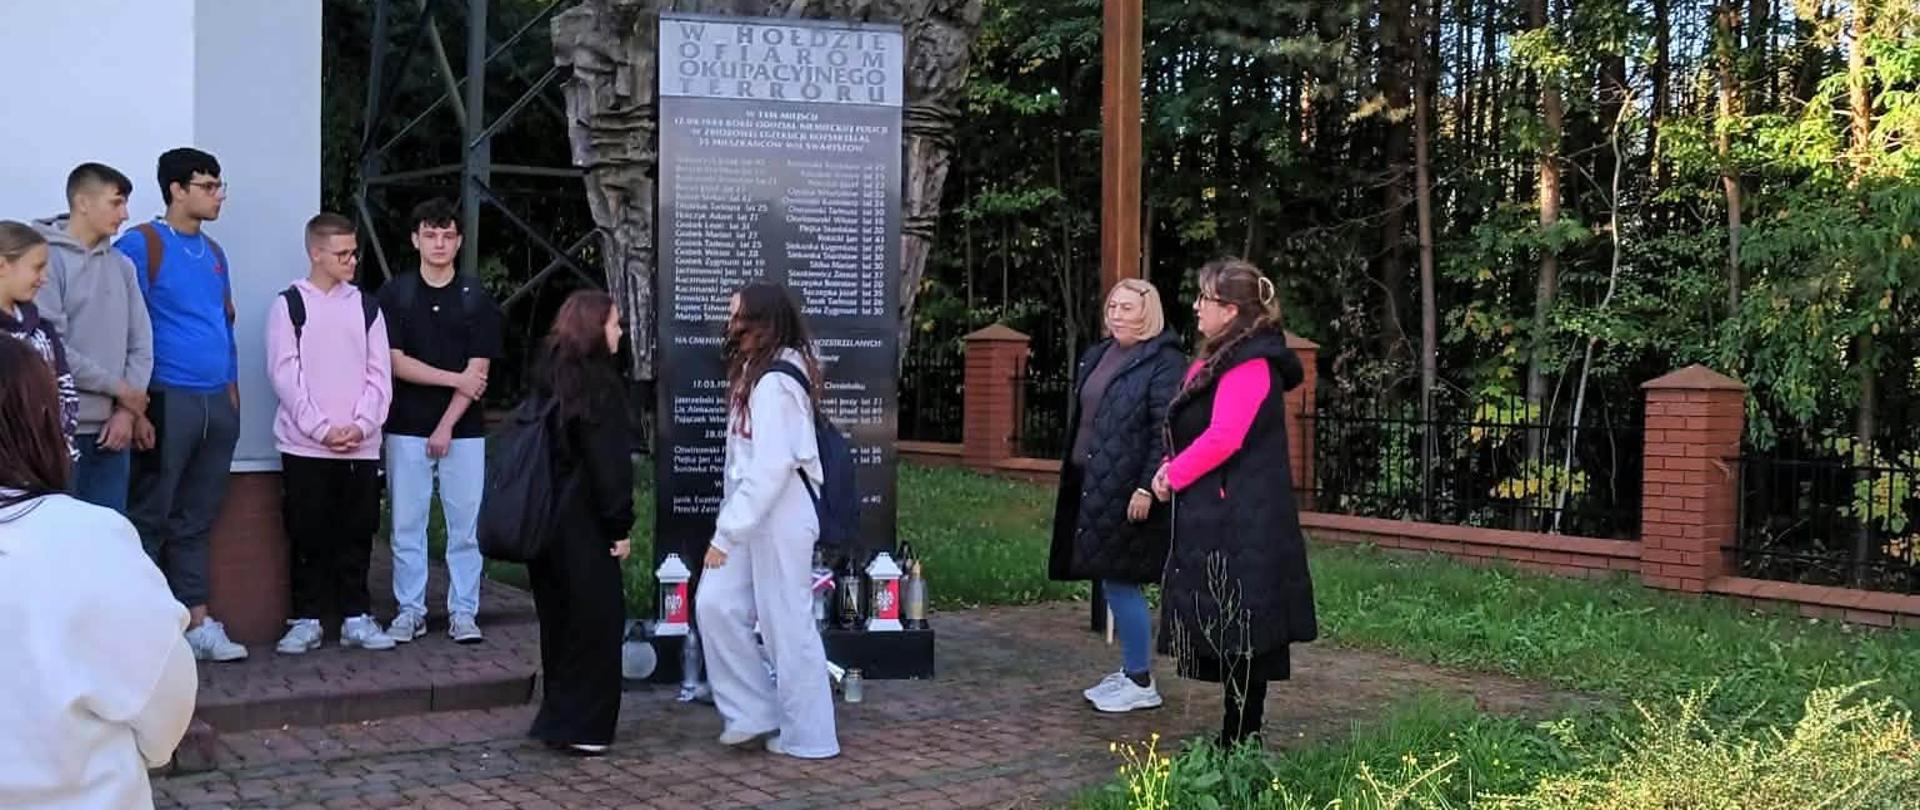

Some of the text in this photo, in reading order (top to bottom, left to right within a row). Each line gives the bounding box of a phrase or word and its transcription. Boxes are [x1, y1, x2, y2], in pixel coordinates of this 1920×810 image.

[680, 24, 886, 50] W HOŁDZIE
[679, 41, 884, 68] OFIAROM
[679, 60, 886, 86] OKUPACYJNEGO
[680, 79, 885, 102] TERRORU
